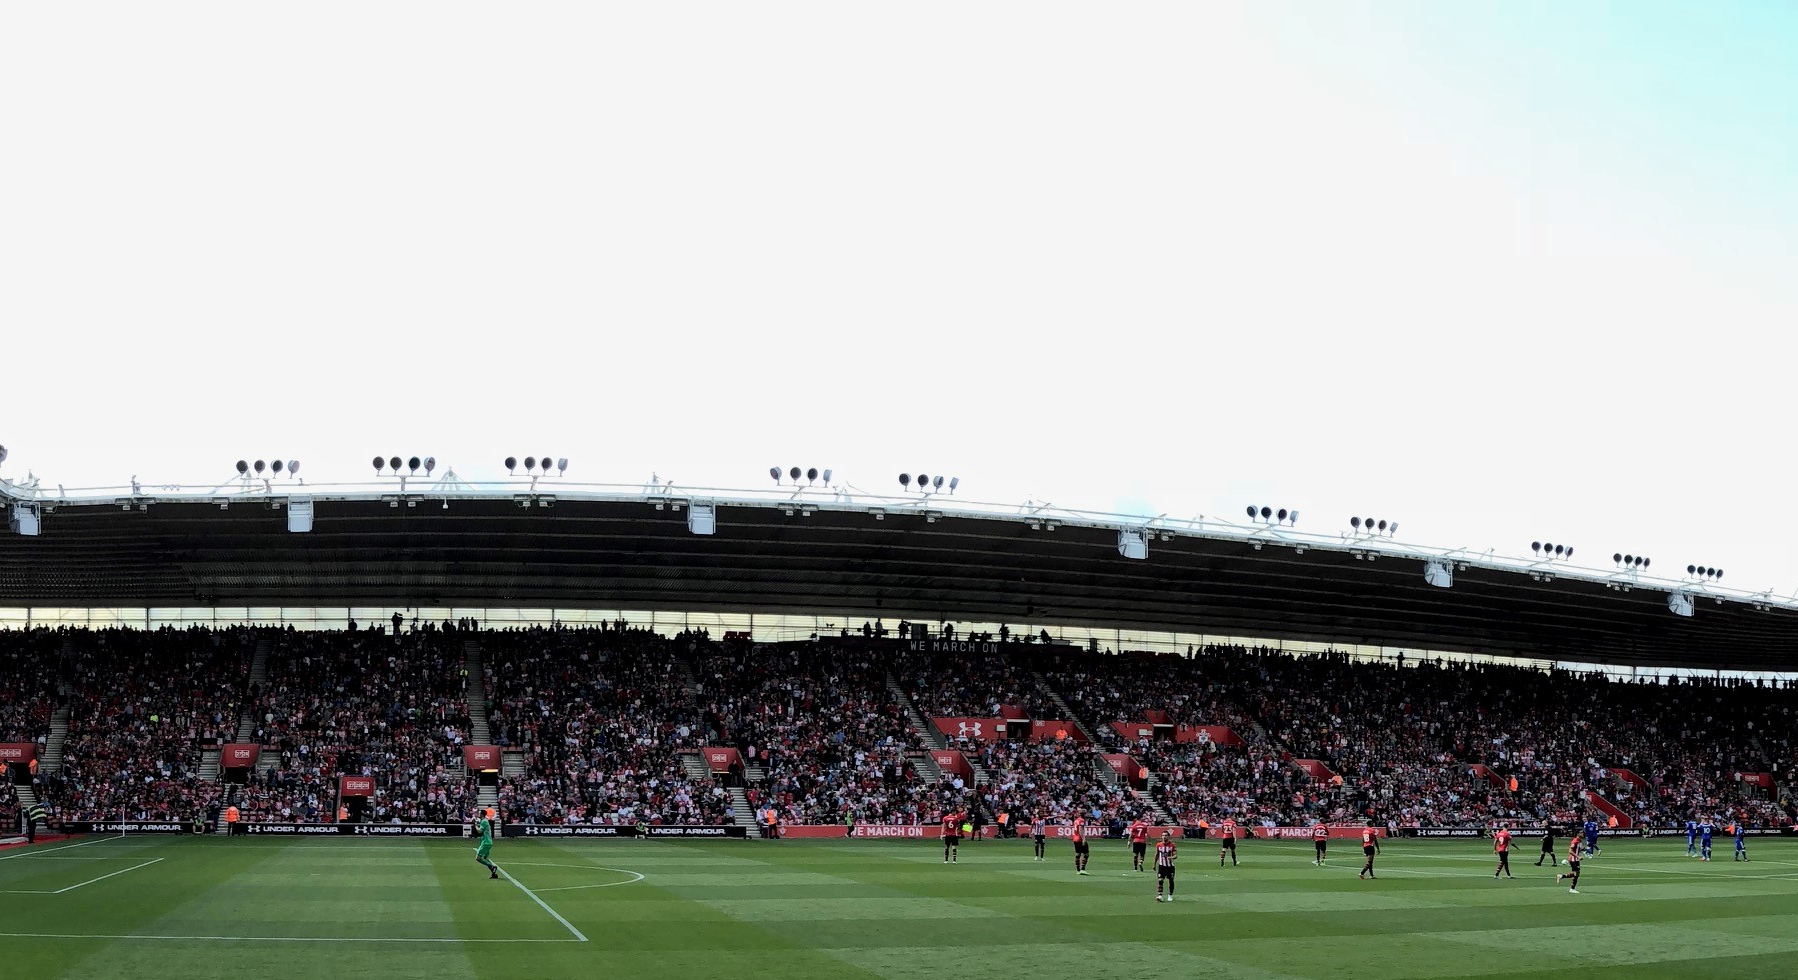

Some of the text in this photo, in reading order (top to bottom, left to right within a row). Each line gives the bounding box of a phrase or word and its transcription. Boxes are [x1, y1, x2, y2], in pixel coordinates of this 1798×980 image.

[933, 642, 975, 652] MARCH
[867, 826, 904, 836] MARCH
[908, 826, 923, 836] ON
[1282, 828, 1313, 836] MARCH
